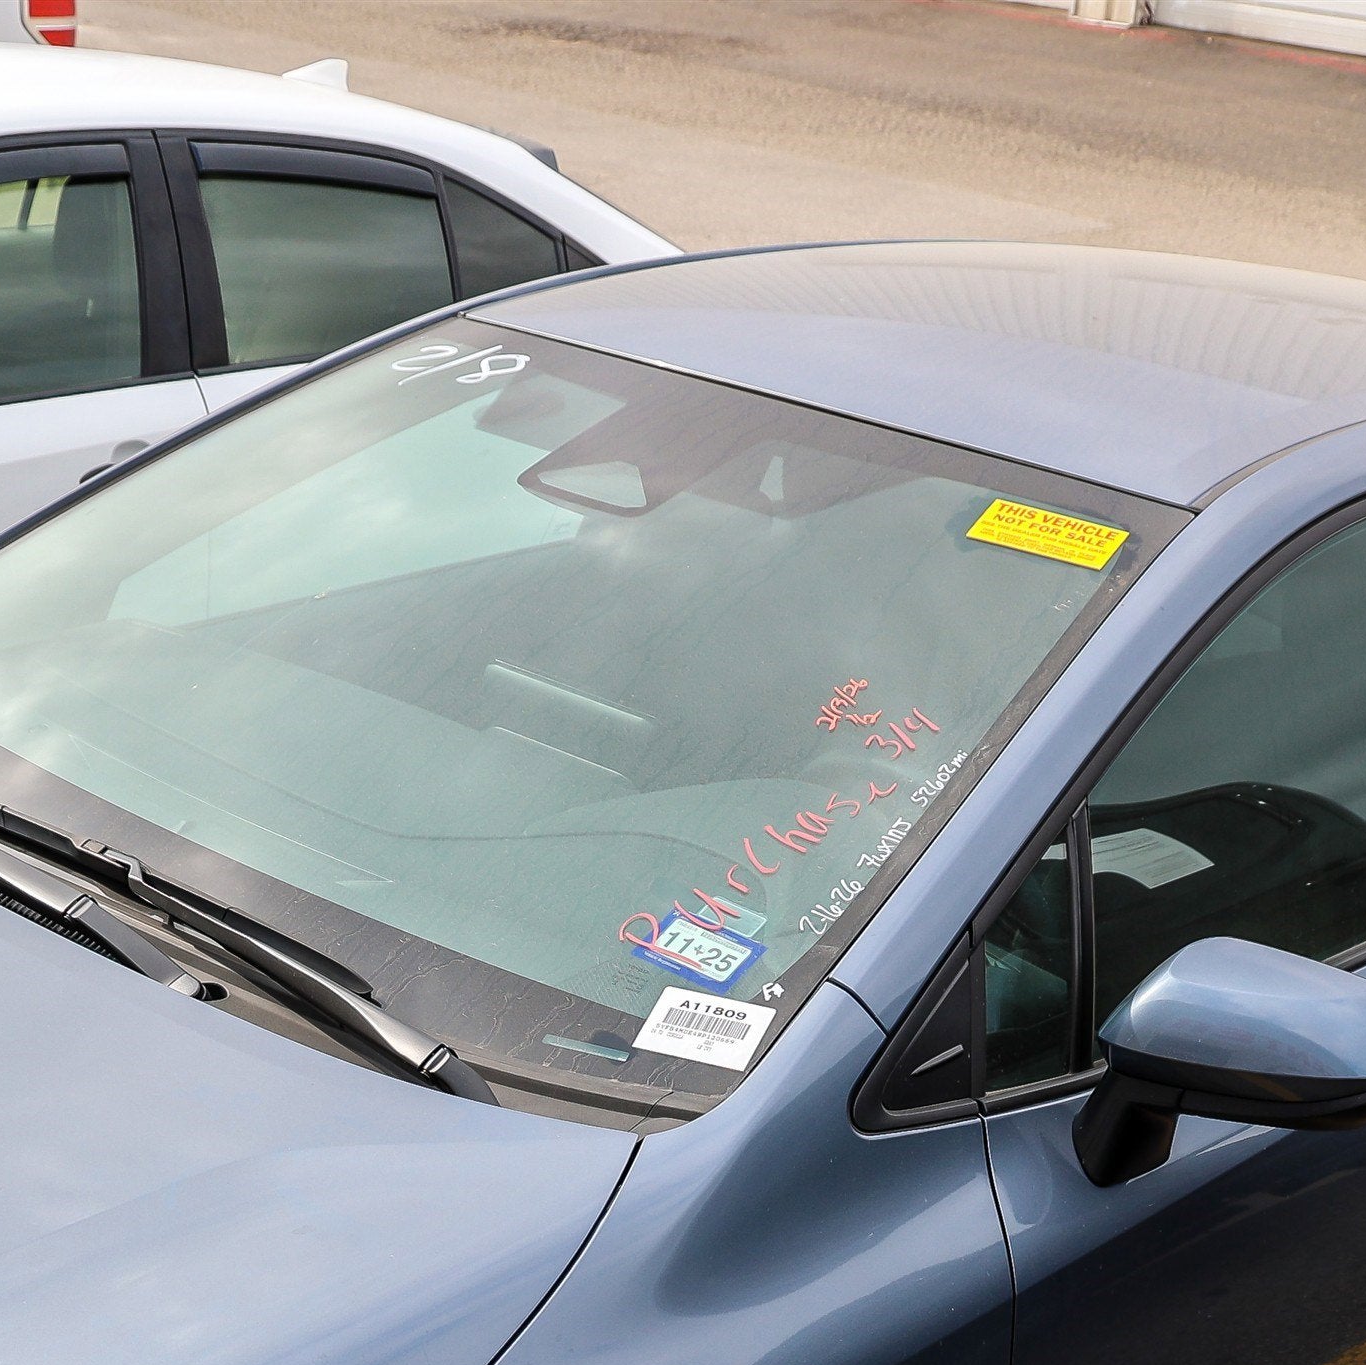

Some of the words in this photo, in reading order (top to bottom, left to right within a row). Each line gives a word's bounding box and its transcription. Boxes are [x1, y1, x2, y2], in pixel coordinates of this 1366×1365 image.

[391, 344, 531, 385] 2/8
[992, 514, 1026, 527] NOT
[1029, 523, 1062, 536] FOR
[1065, 532, 1108, 548] SALE
[998, 502, 1036, 520] THIS
[1042, 513, 1119, 541] VEHICLE
[798, 878, 866, 936] 2-16-26
[680, 999, 748, 1021] A11809
